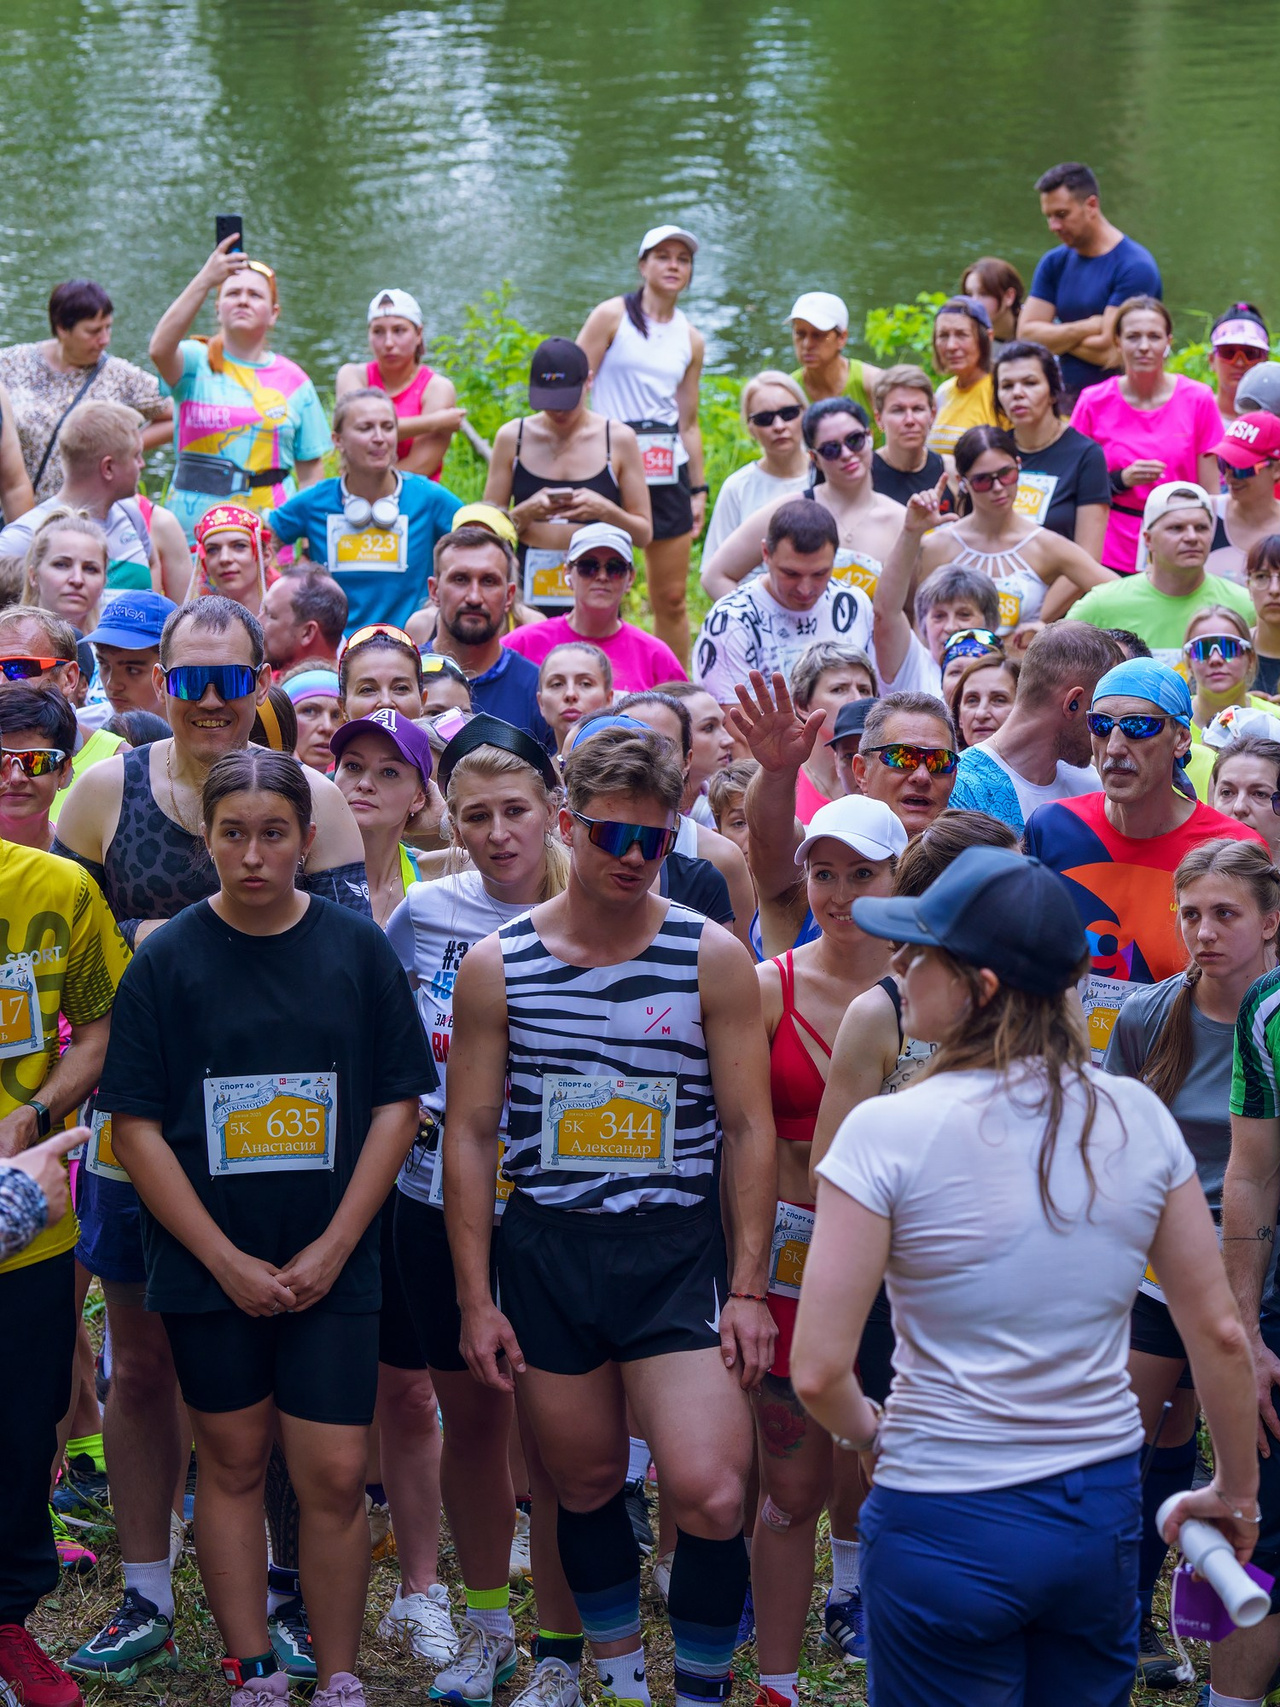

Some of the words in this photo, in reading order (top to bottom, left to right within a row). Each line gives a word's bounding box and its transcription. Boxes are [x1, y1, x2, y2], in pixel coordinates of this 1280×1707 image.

[361, 534, 396, 553] 323
[841, 571, 875, 591] 427
[431, 971, 457, 999] 45
[1087, 1000, 1123, 1010] Лукомор
[267, 1108, 320, 1138] 635
[600, 1111, 656, 1140] 344
[240, 1141, 316, 1154] Анастасия
[570, 1139, 651, 1159] Александр
